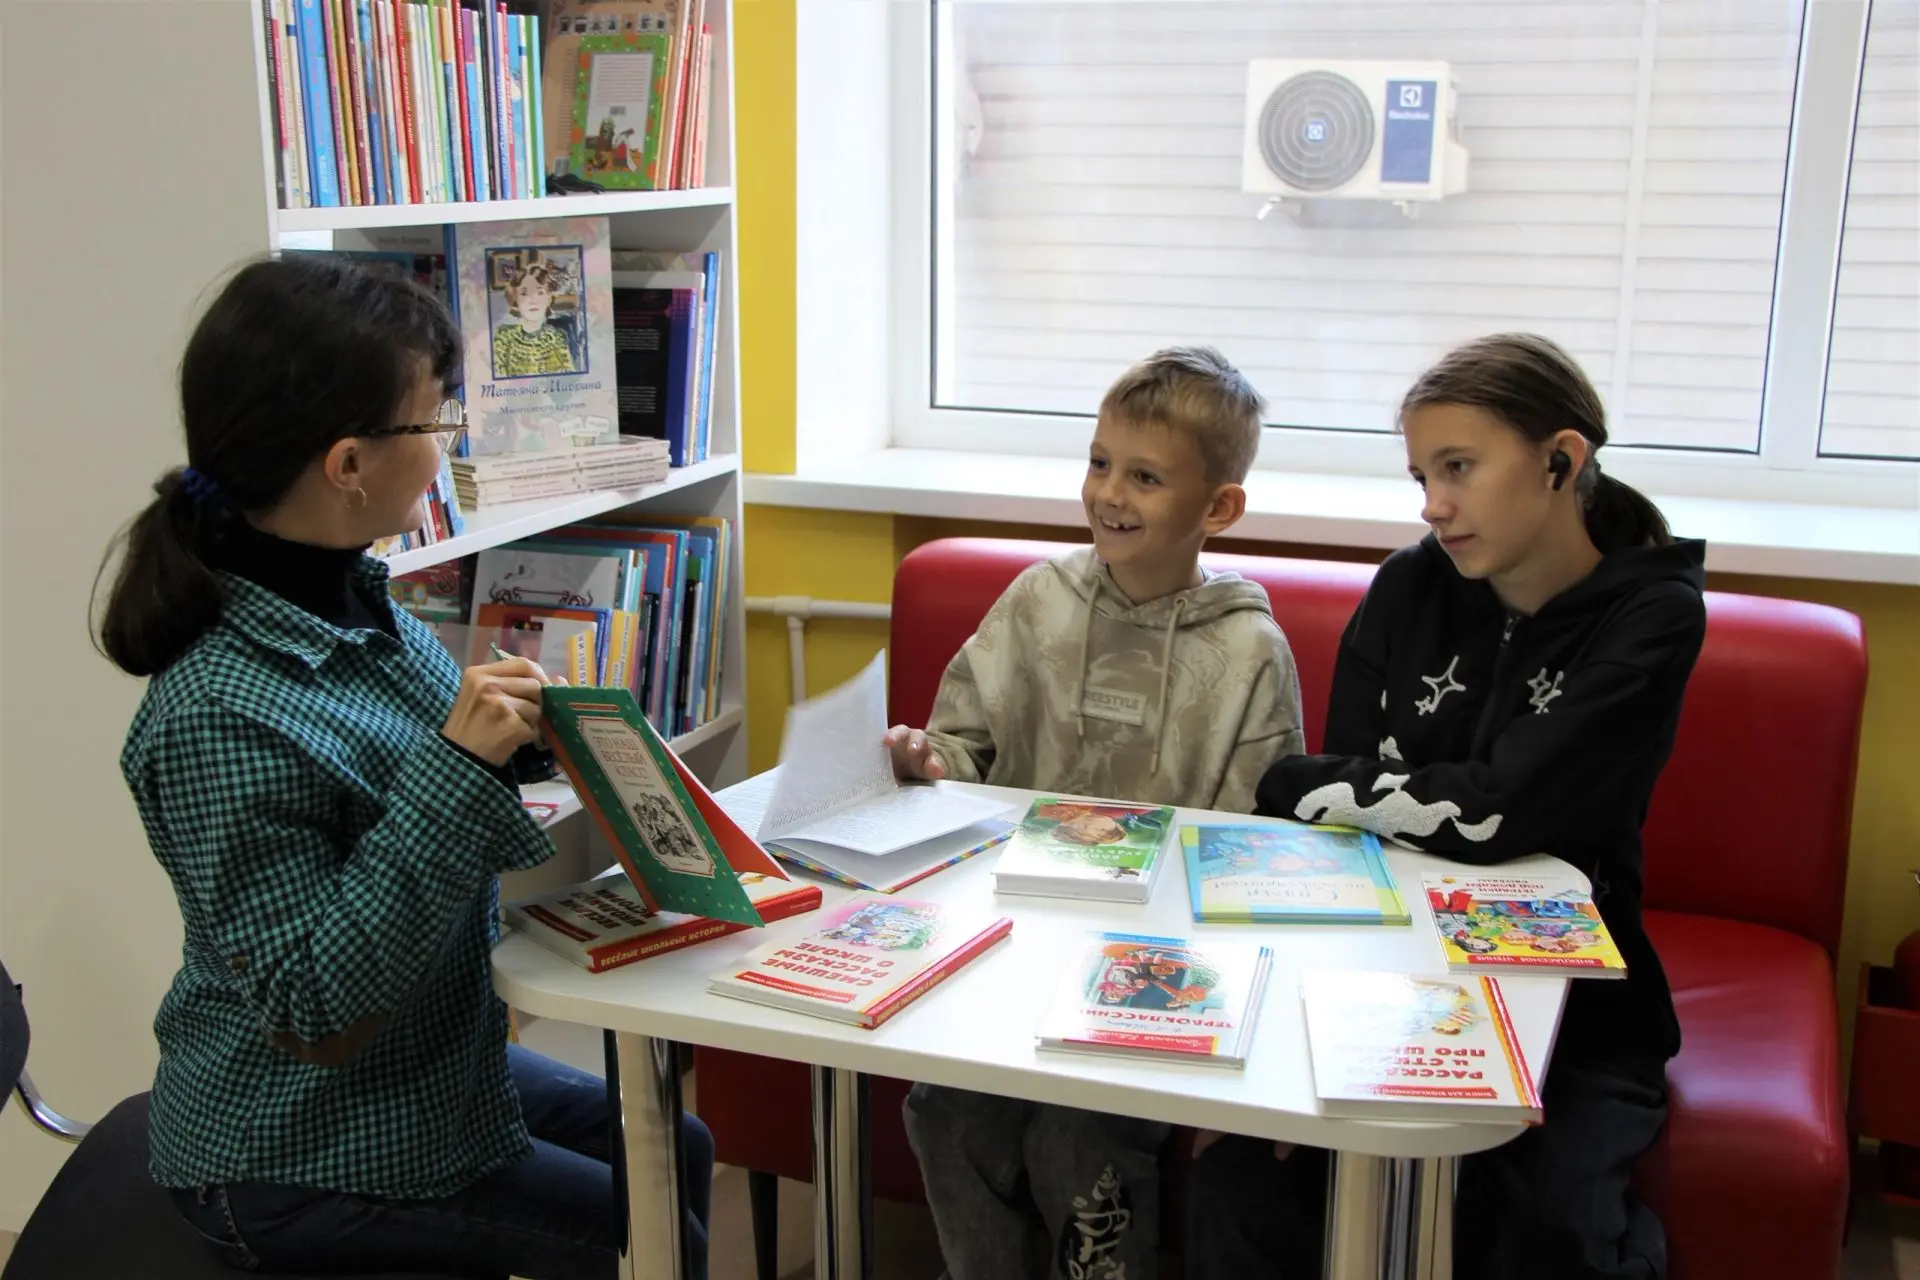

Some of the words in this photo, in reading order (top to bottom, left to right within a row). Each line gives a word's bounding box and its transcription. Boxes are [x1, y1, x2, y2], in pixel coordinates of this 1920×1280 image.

[1084, 692, 1141, 710] REESTYLE
[640, 935, 686, 954] ШКОЛЬНЫЕ
[688, 924, 727, 941] ИСТОРИИ
[795, 943, 873, 963] ШКОЛЕ
[761, 958, 874, 986] СМЕШНЫЕ
[774, 949, 890, 979] РАССКАЗЫ
[877, 960, 894, 968] О
[1080, 1009, 1234, 1029] ЕРВОКЛАССНИ
[1435, 1047, 1486, 1058] ПРО
[1352, 1068, 1484, 1080] РАССКА
